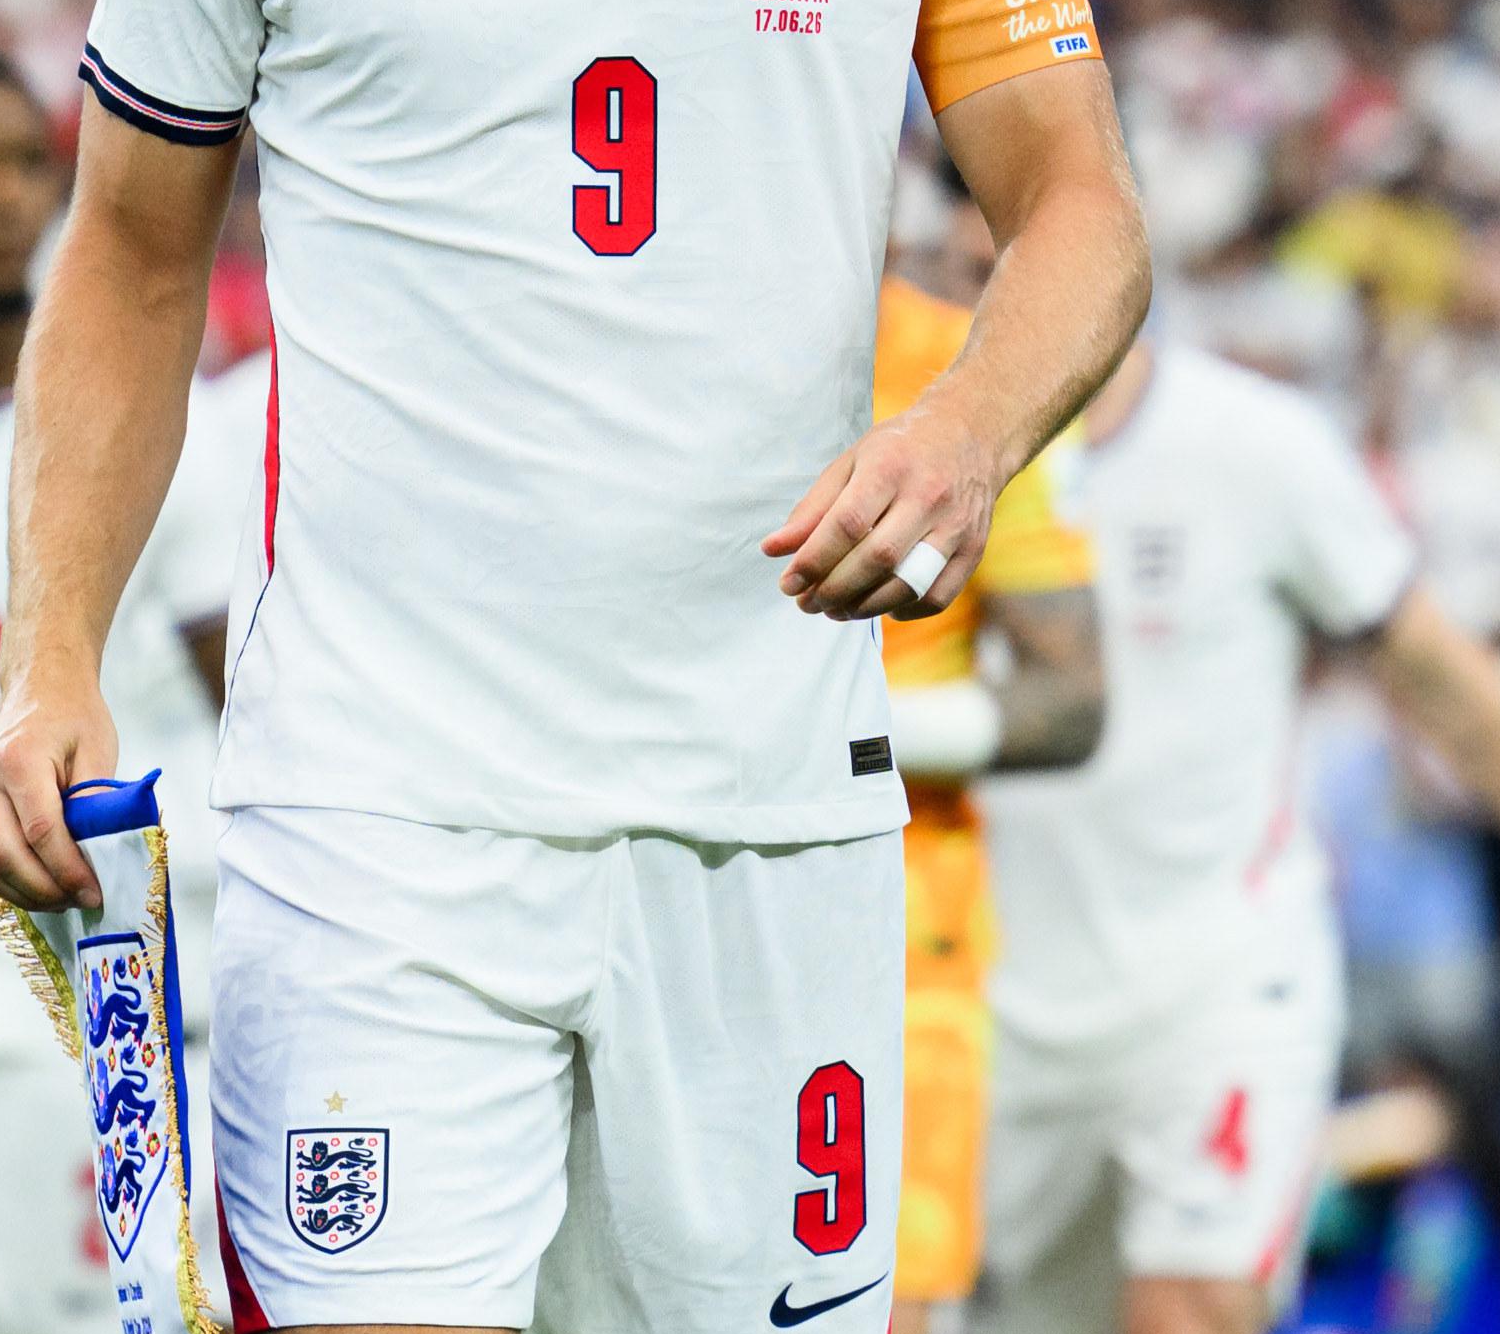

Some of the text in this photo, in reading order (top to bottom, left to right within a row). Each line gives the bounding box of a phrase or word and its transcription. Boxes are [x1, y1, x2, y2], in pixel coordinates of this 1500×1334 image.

[755, 8, 822, 34] 17.06.26
[1002, 9, 1051, 42] the
[1055, 36, 1088, 53] FIFA
[572, 56, 658, 257] 9
[793, 1060, 867, 1257] 9
[1200, 1087, 1250, 1177] 4
